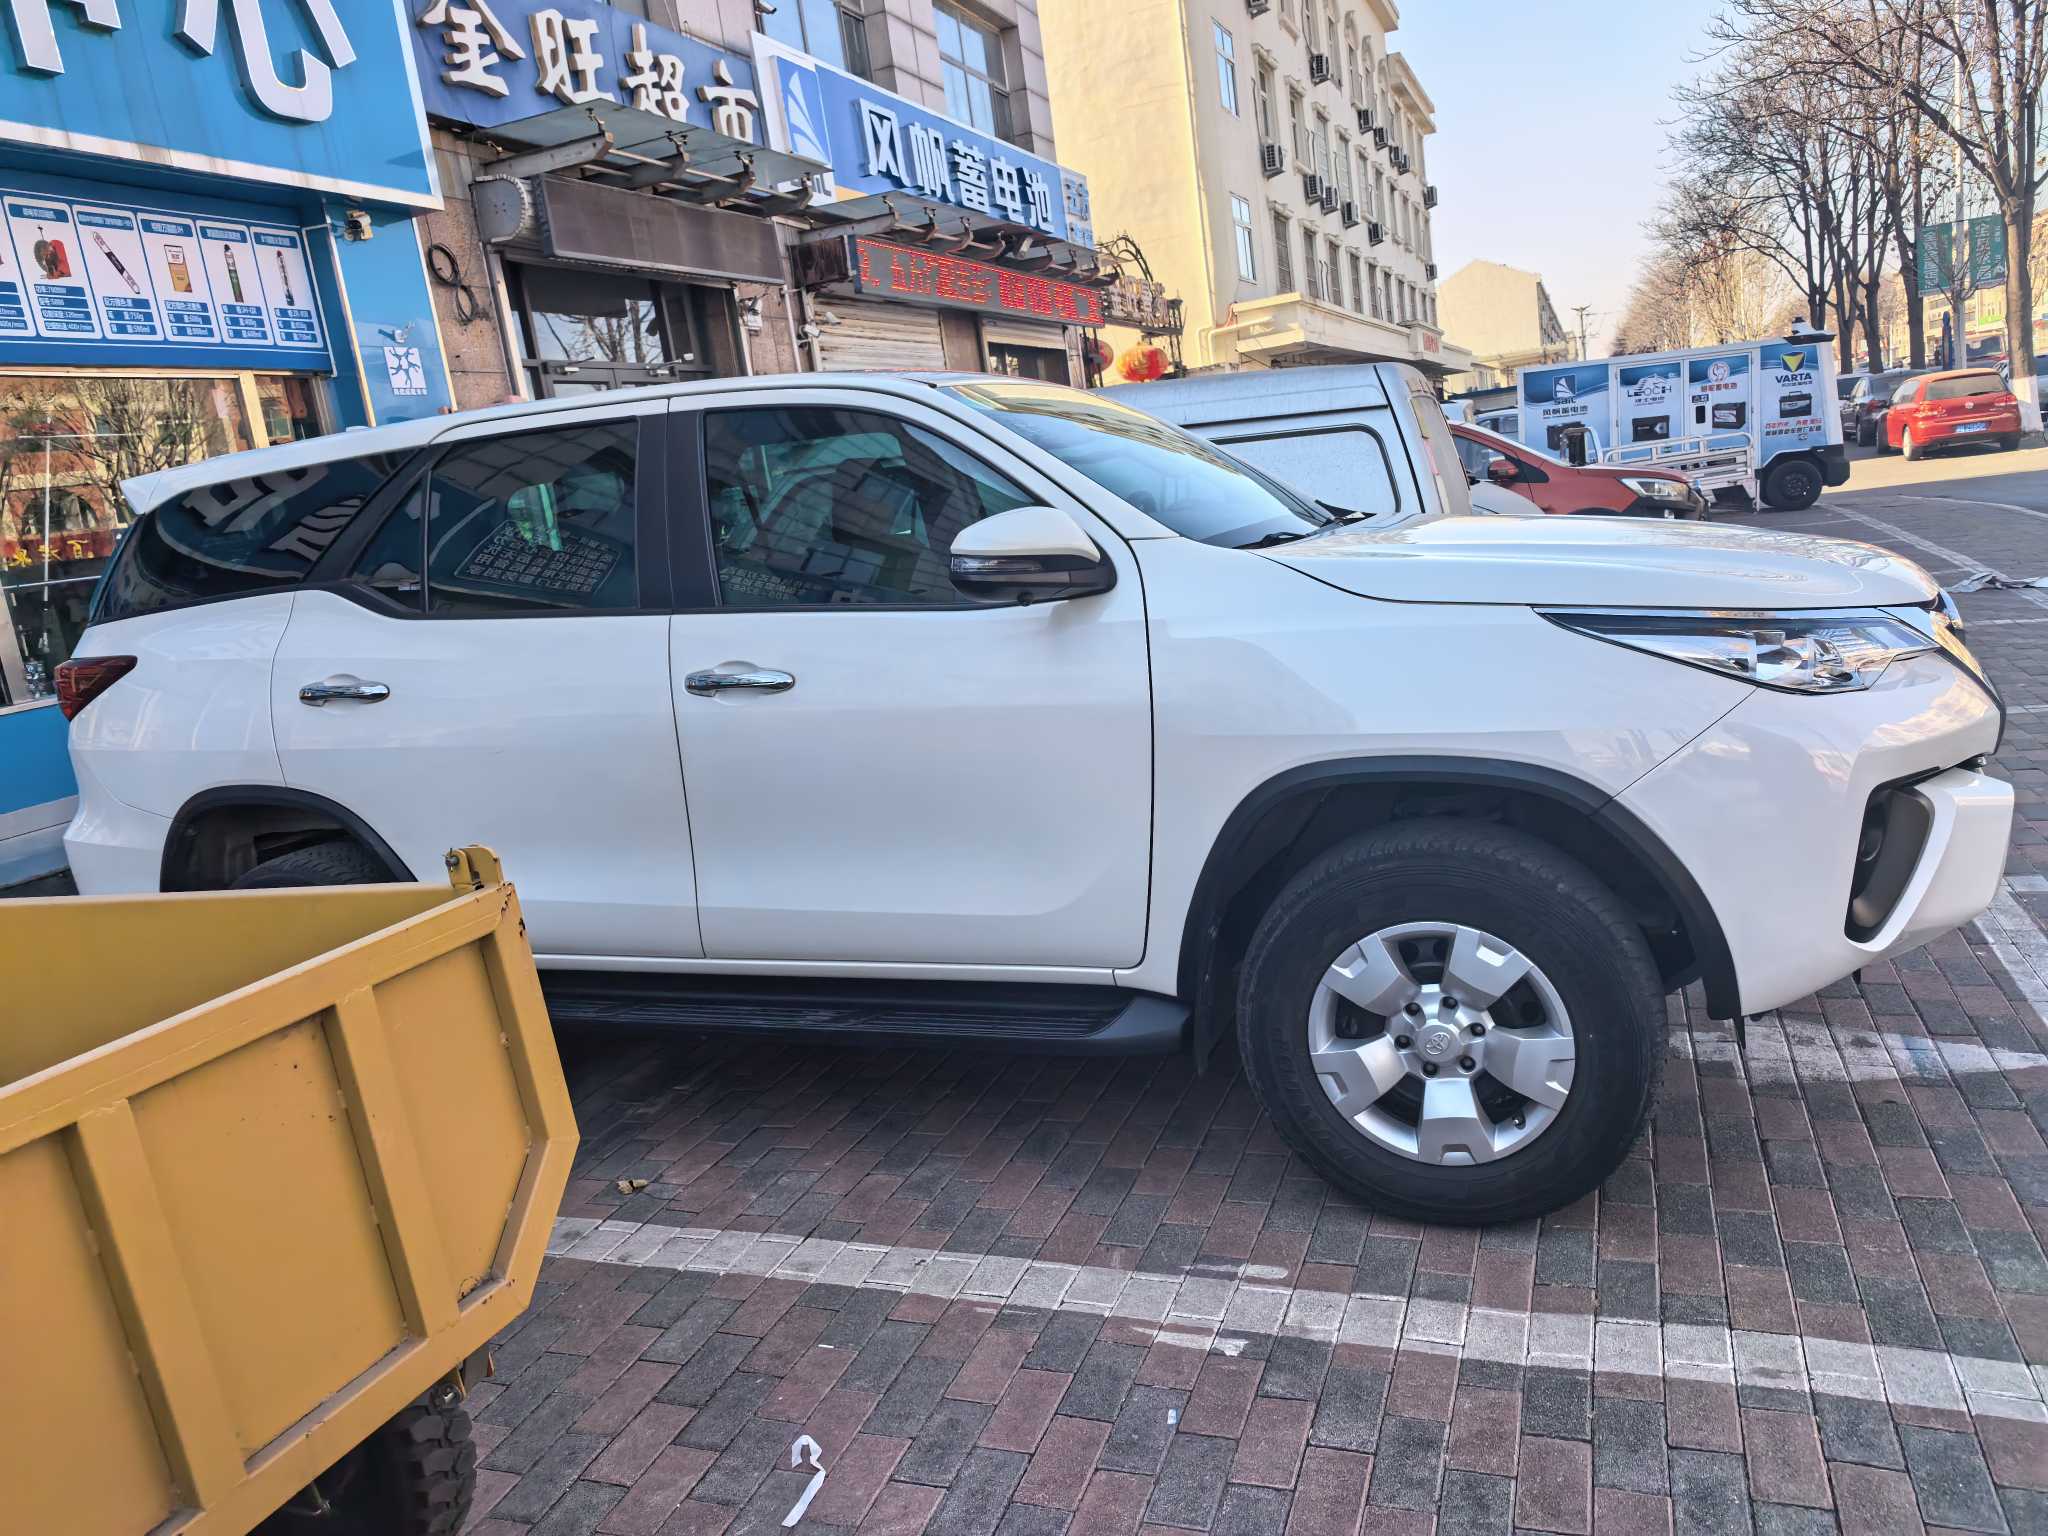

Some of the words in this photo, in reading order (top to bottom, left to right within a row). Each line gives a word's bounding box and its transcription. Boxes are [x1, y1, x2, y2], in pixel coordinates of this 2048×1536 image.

[417, 0, 760, 145] 金旺超市
[857, 97, 1055, 233] 风帆蓄电池
[1775, 372, 1813, 384] VARTA
